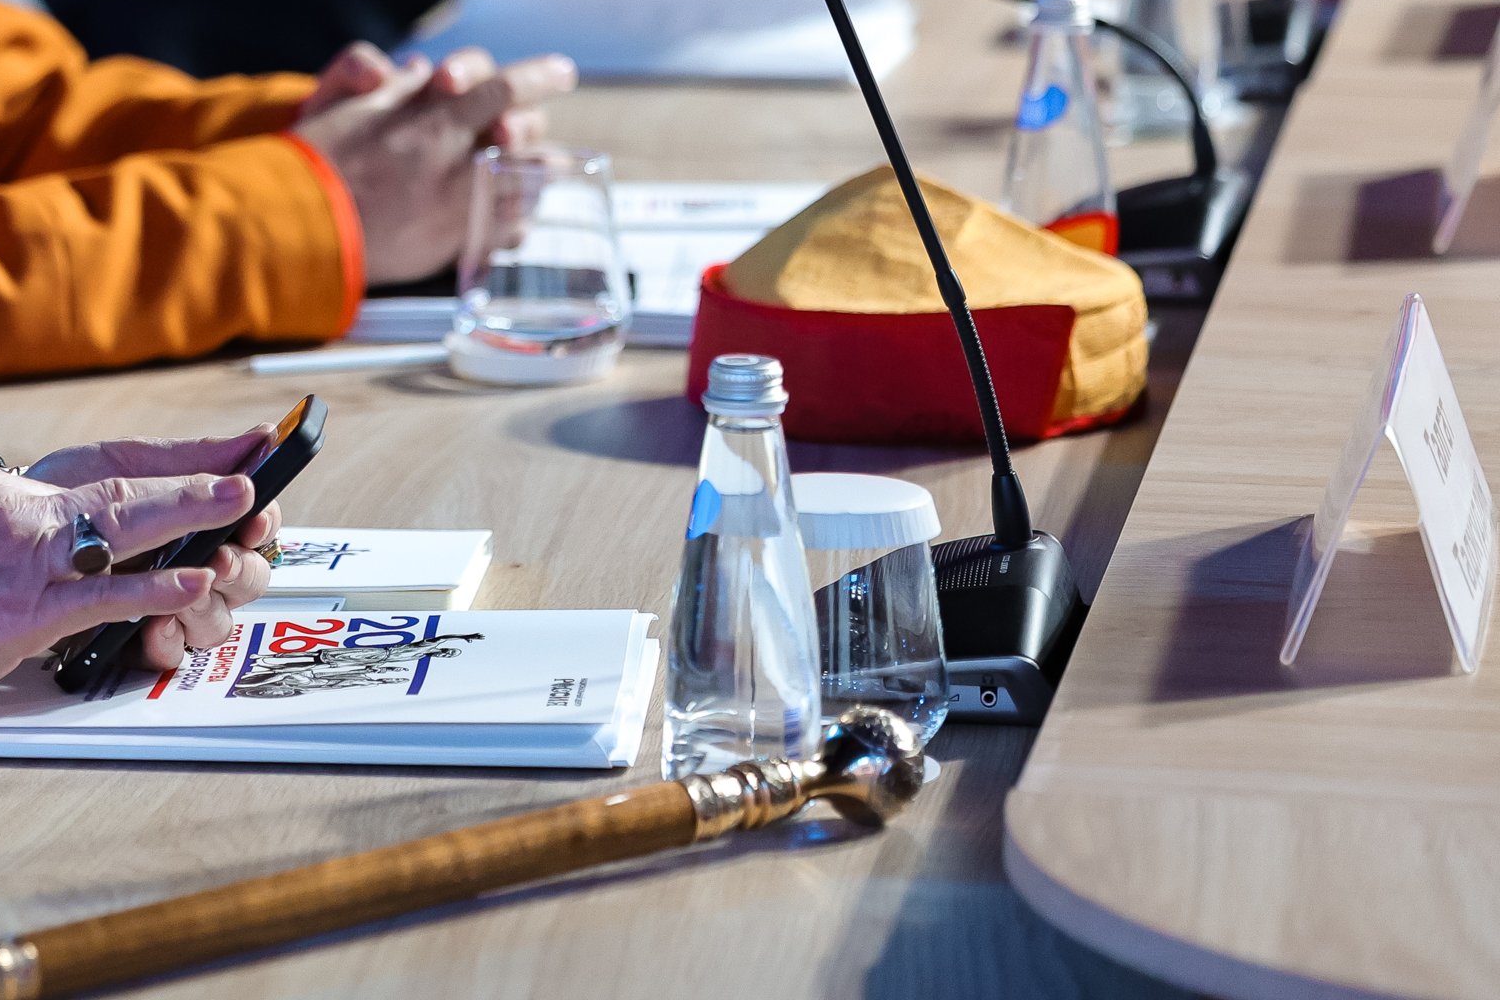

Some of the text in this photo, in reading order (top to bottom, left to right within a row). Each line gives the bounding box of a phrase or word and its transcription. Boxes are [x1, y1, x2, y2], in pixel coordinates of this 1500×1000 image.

[1423, 397, 1455, 485] Талгат
[267, 619, 345, 654] 26
[343, 616, 419, 649] 20
[176, 668, 205, 691] РОССИИ
[206, 645, 238, 683] ЕДИНСТВА
